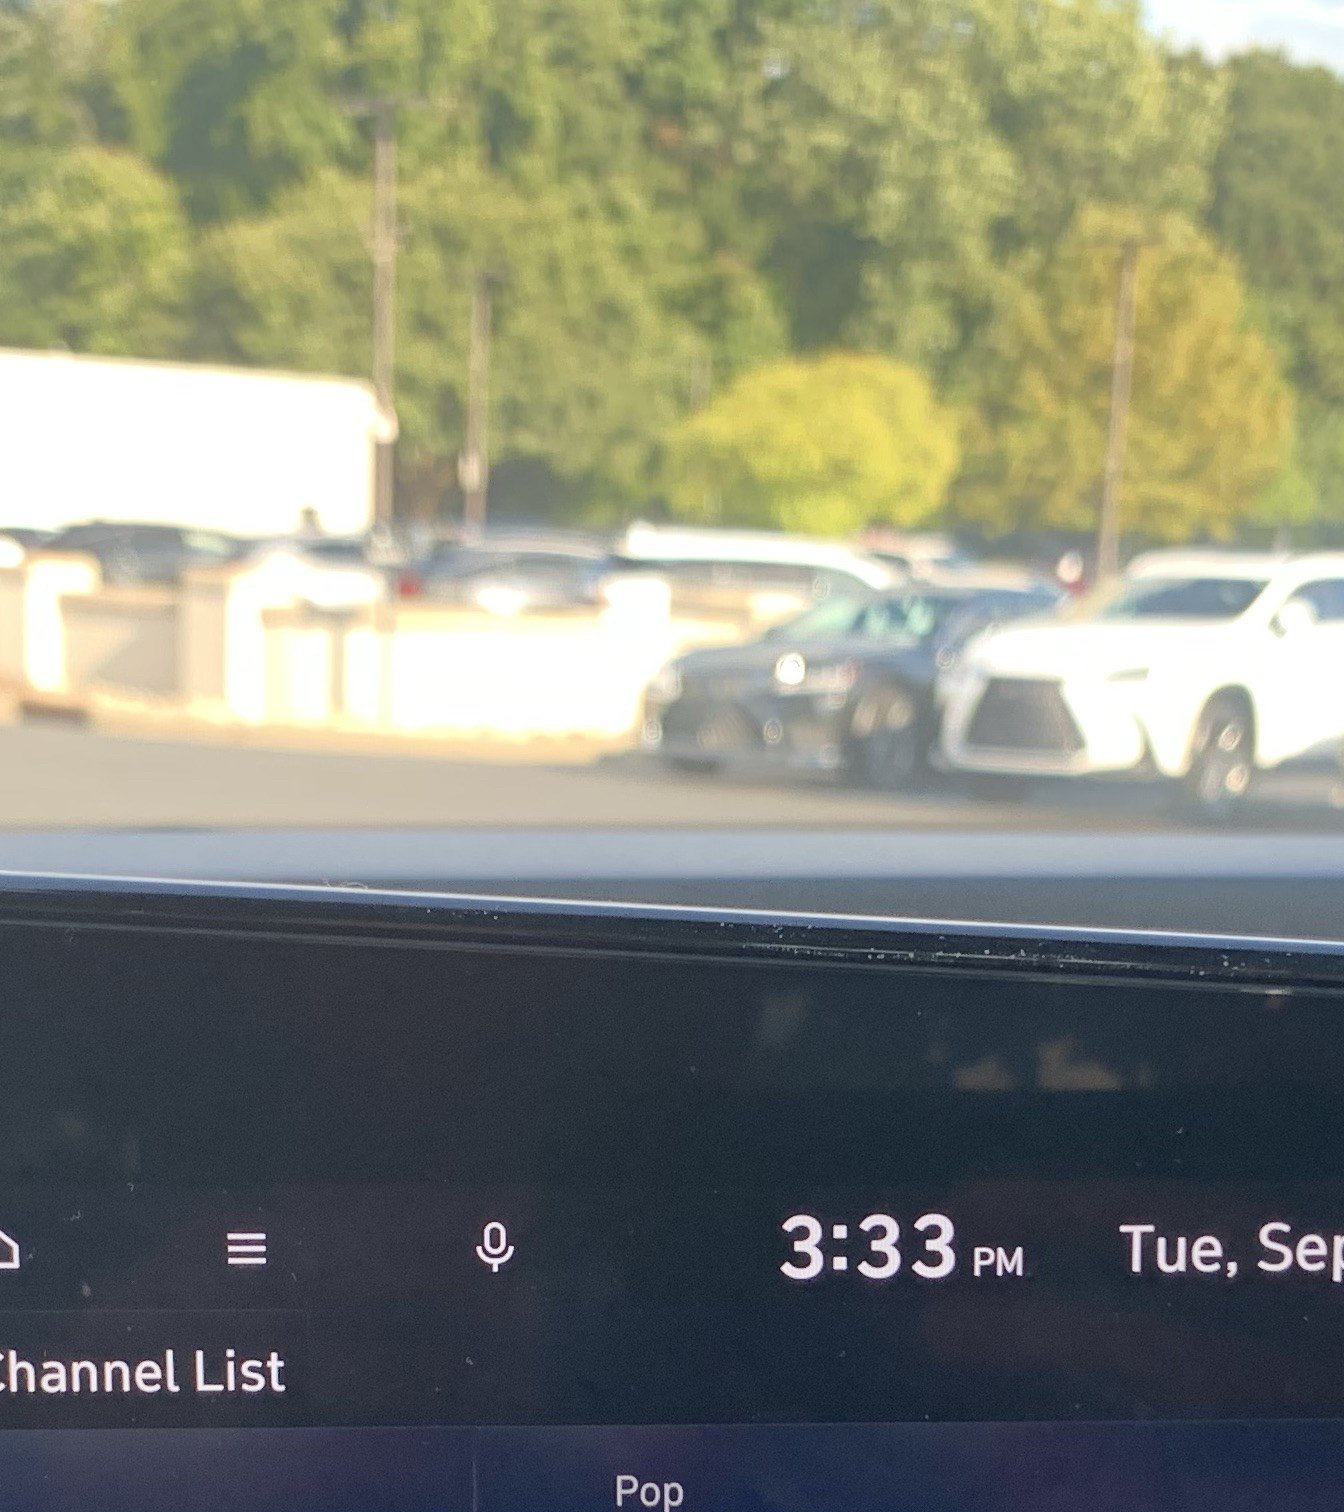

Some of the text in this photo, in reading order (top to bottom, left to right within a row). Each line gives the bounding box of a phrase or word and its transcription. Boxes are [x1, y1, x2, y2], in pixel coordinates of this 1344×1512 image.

[779, 1213, 1024, 1280] 3:33 PM
[1118, 1224, 1238, 1278] Tue,
[195, 1348, 287, 1393] List
